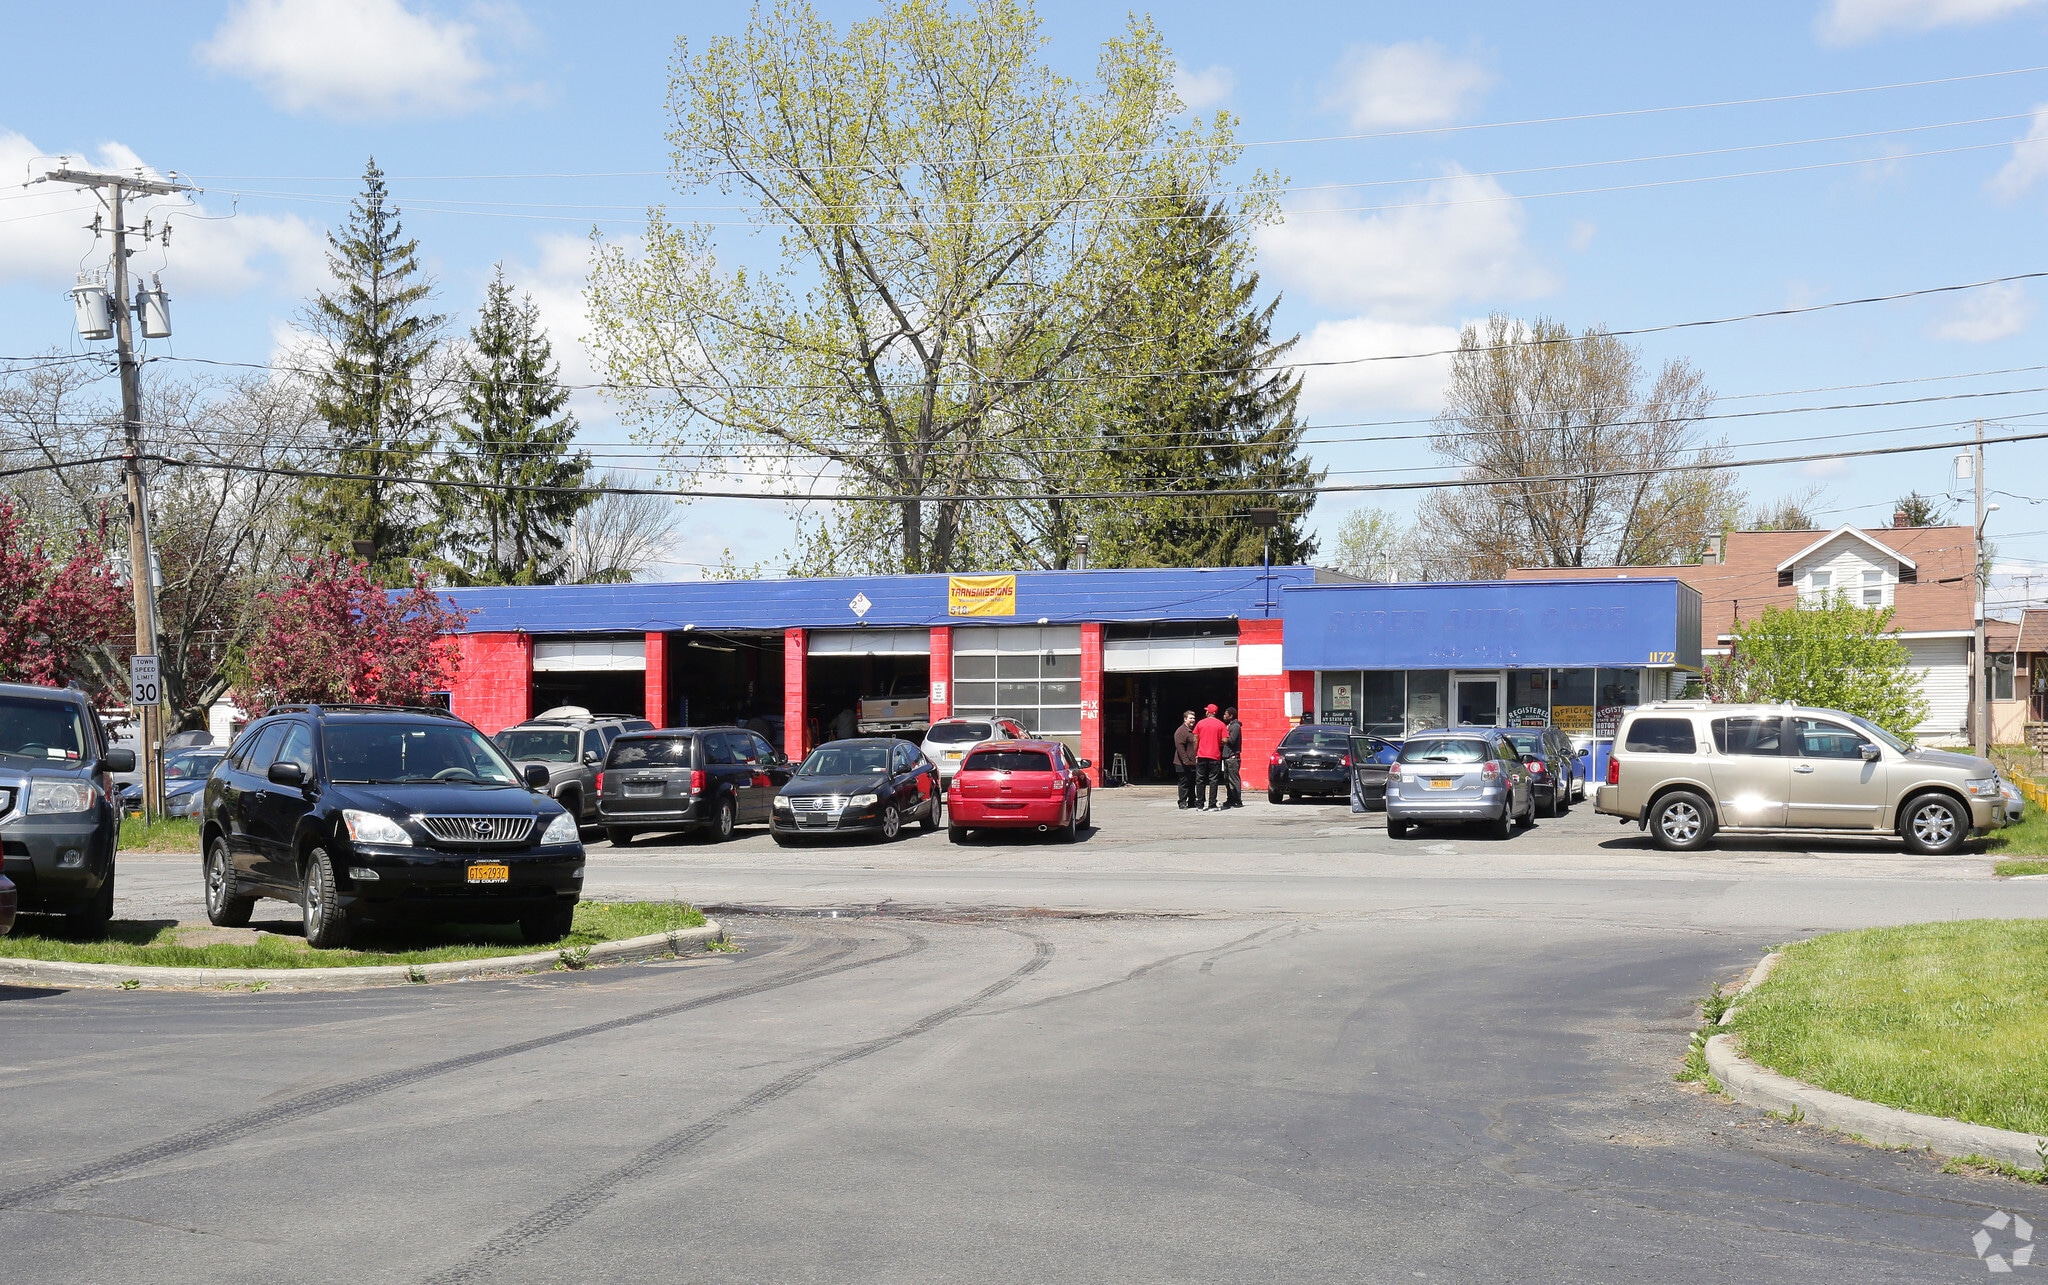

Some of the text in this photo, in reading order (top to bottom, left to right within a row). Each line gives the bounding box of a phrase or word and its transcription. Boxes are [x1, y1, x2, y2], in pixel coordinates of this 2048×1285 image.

[951, 587, 1013, 597] TRANSMISSIONS
[857, 594, 864, 603] 3
[851, 600, 858, 609] 2
[1649, 651, 1675, 663] 1172
[135, 683, 156, 701] 30
[1081, 700, 1098, 710] FIX
[1508, 707, 1549, 718] REGISTERED
[1554, 707, 1593, 718] OFFICIAL
